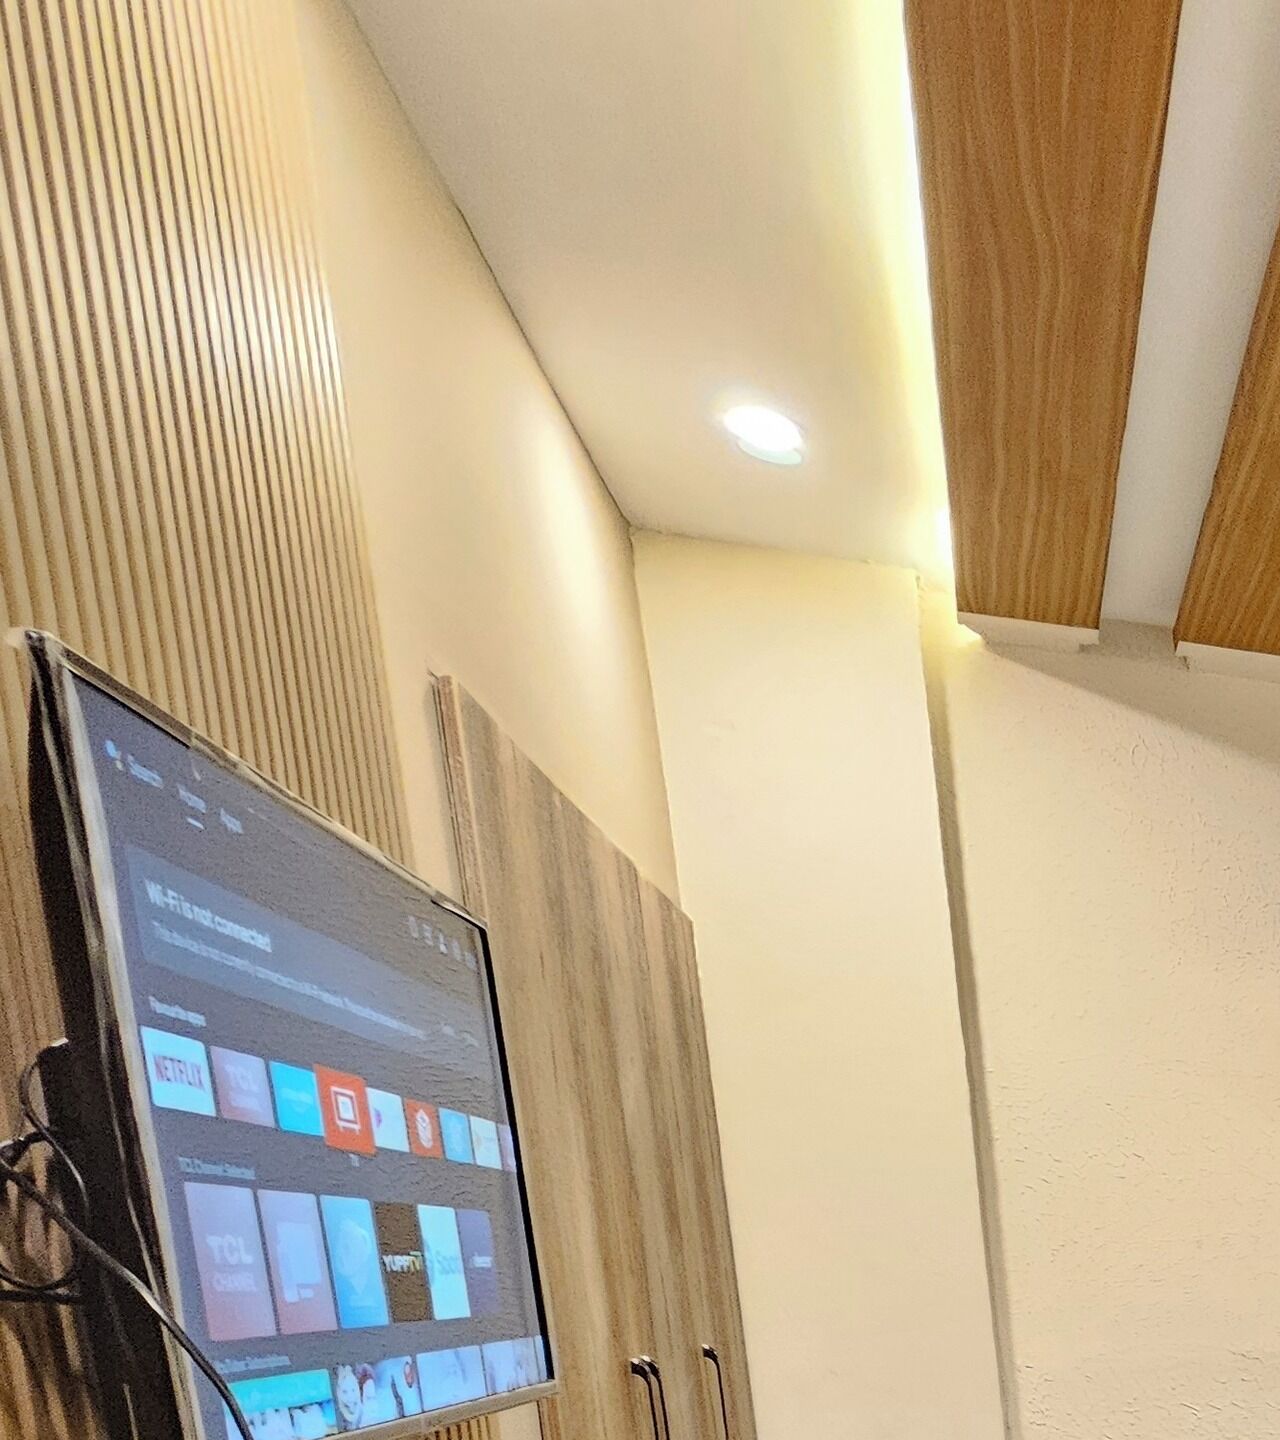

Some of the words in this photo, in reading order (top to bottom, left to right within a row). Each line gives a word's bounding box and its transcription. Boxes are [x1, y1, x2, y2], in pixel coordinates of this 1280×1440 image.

[144, 878, 182, 915] Wi-Fi
[193, 904, 214, 929] not
[215, 914, 272, 952] connected
[153, 1055, 205, 1091] NETFLIX
[206, 1234, 253, 1265] TCL
